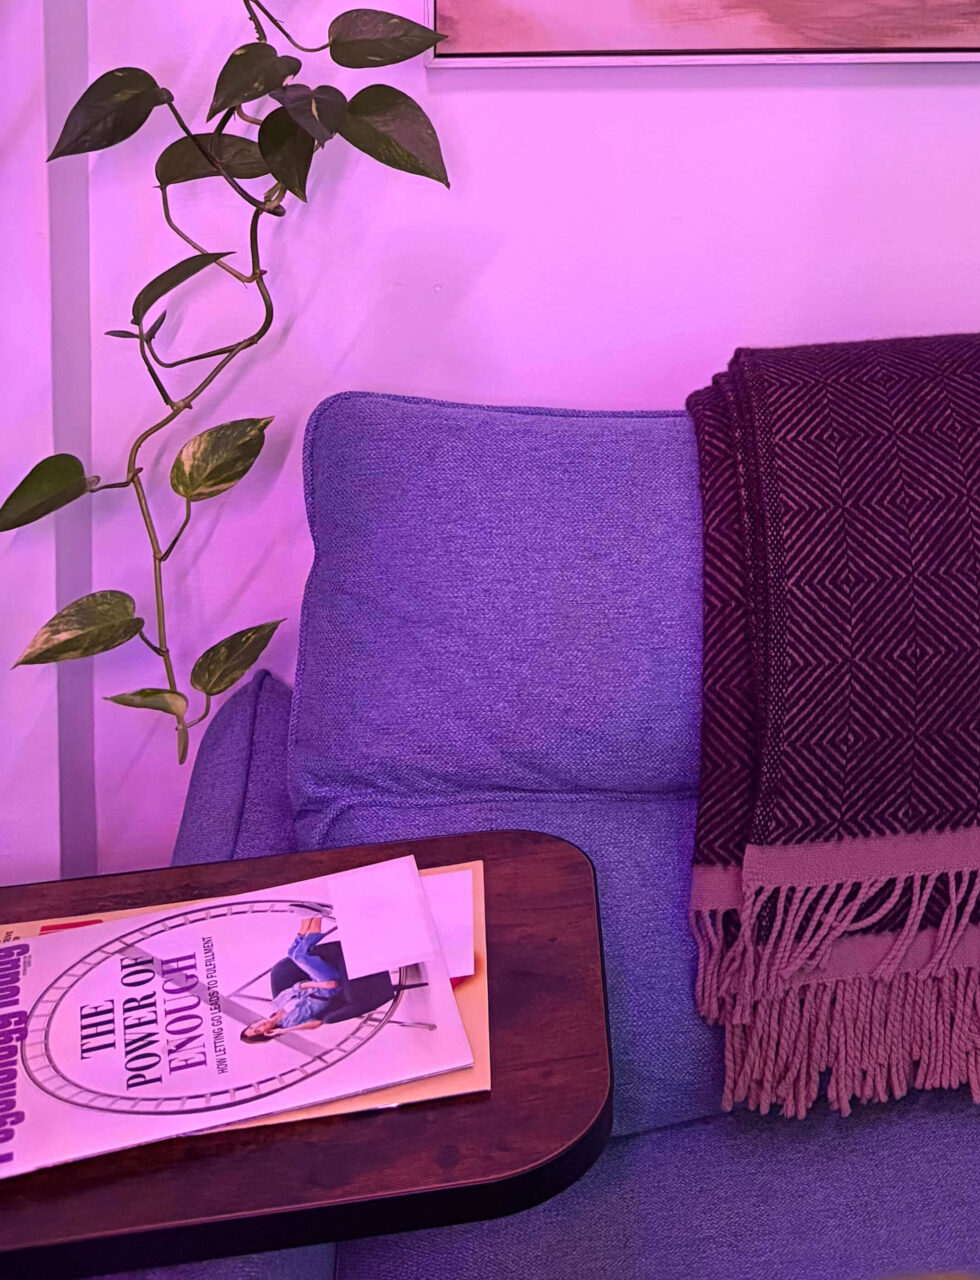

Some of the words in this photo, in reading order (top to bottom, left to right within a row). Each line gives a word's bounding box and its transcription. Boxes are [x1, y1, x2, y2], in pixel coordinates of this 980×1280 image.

[120, 956, 156, 987] OF
[202, 936, 218, 979] FULFILLMENT
[207, 979, 218, 990] TO
[160, 952, 207, 1075] ENOUGH
[208, 990, 221, 1014] LEADS
[80, 999, 116, 1060] THE
[211, 1015, 223, 1027] GO
[122, 990, 163, 1091] POWER
[212, 1027, 227, 1056] LETTING
[214, 1057, 228, 1074] HOW
